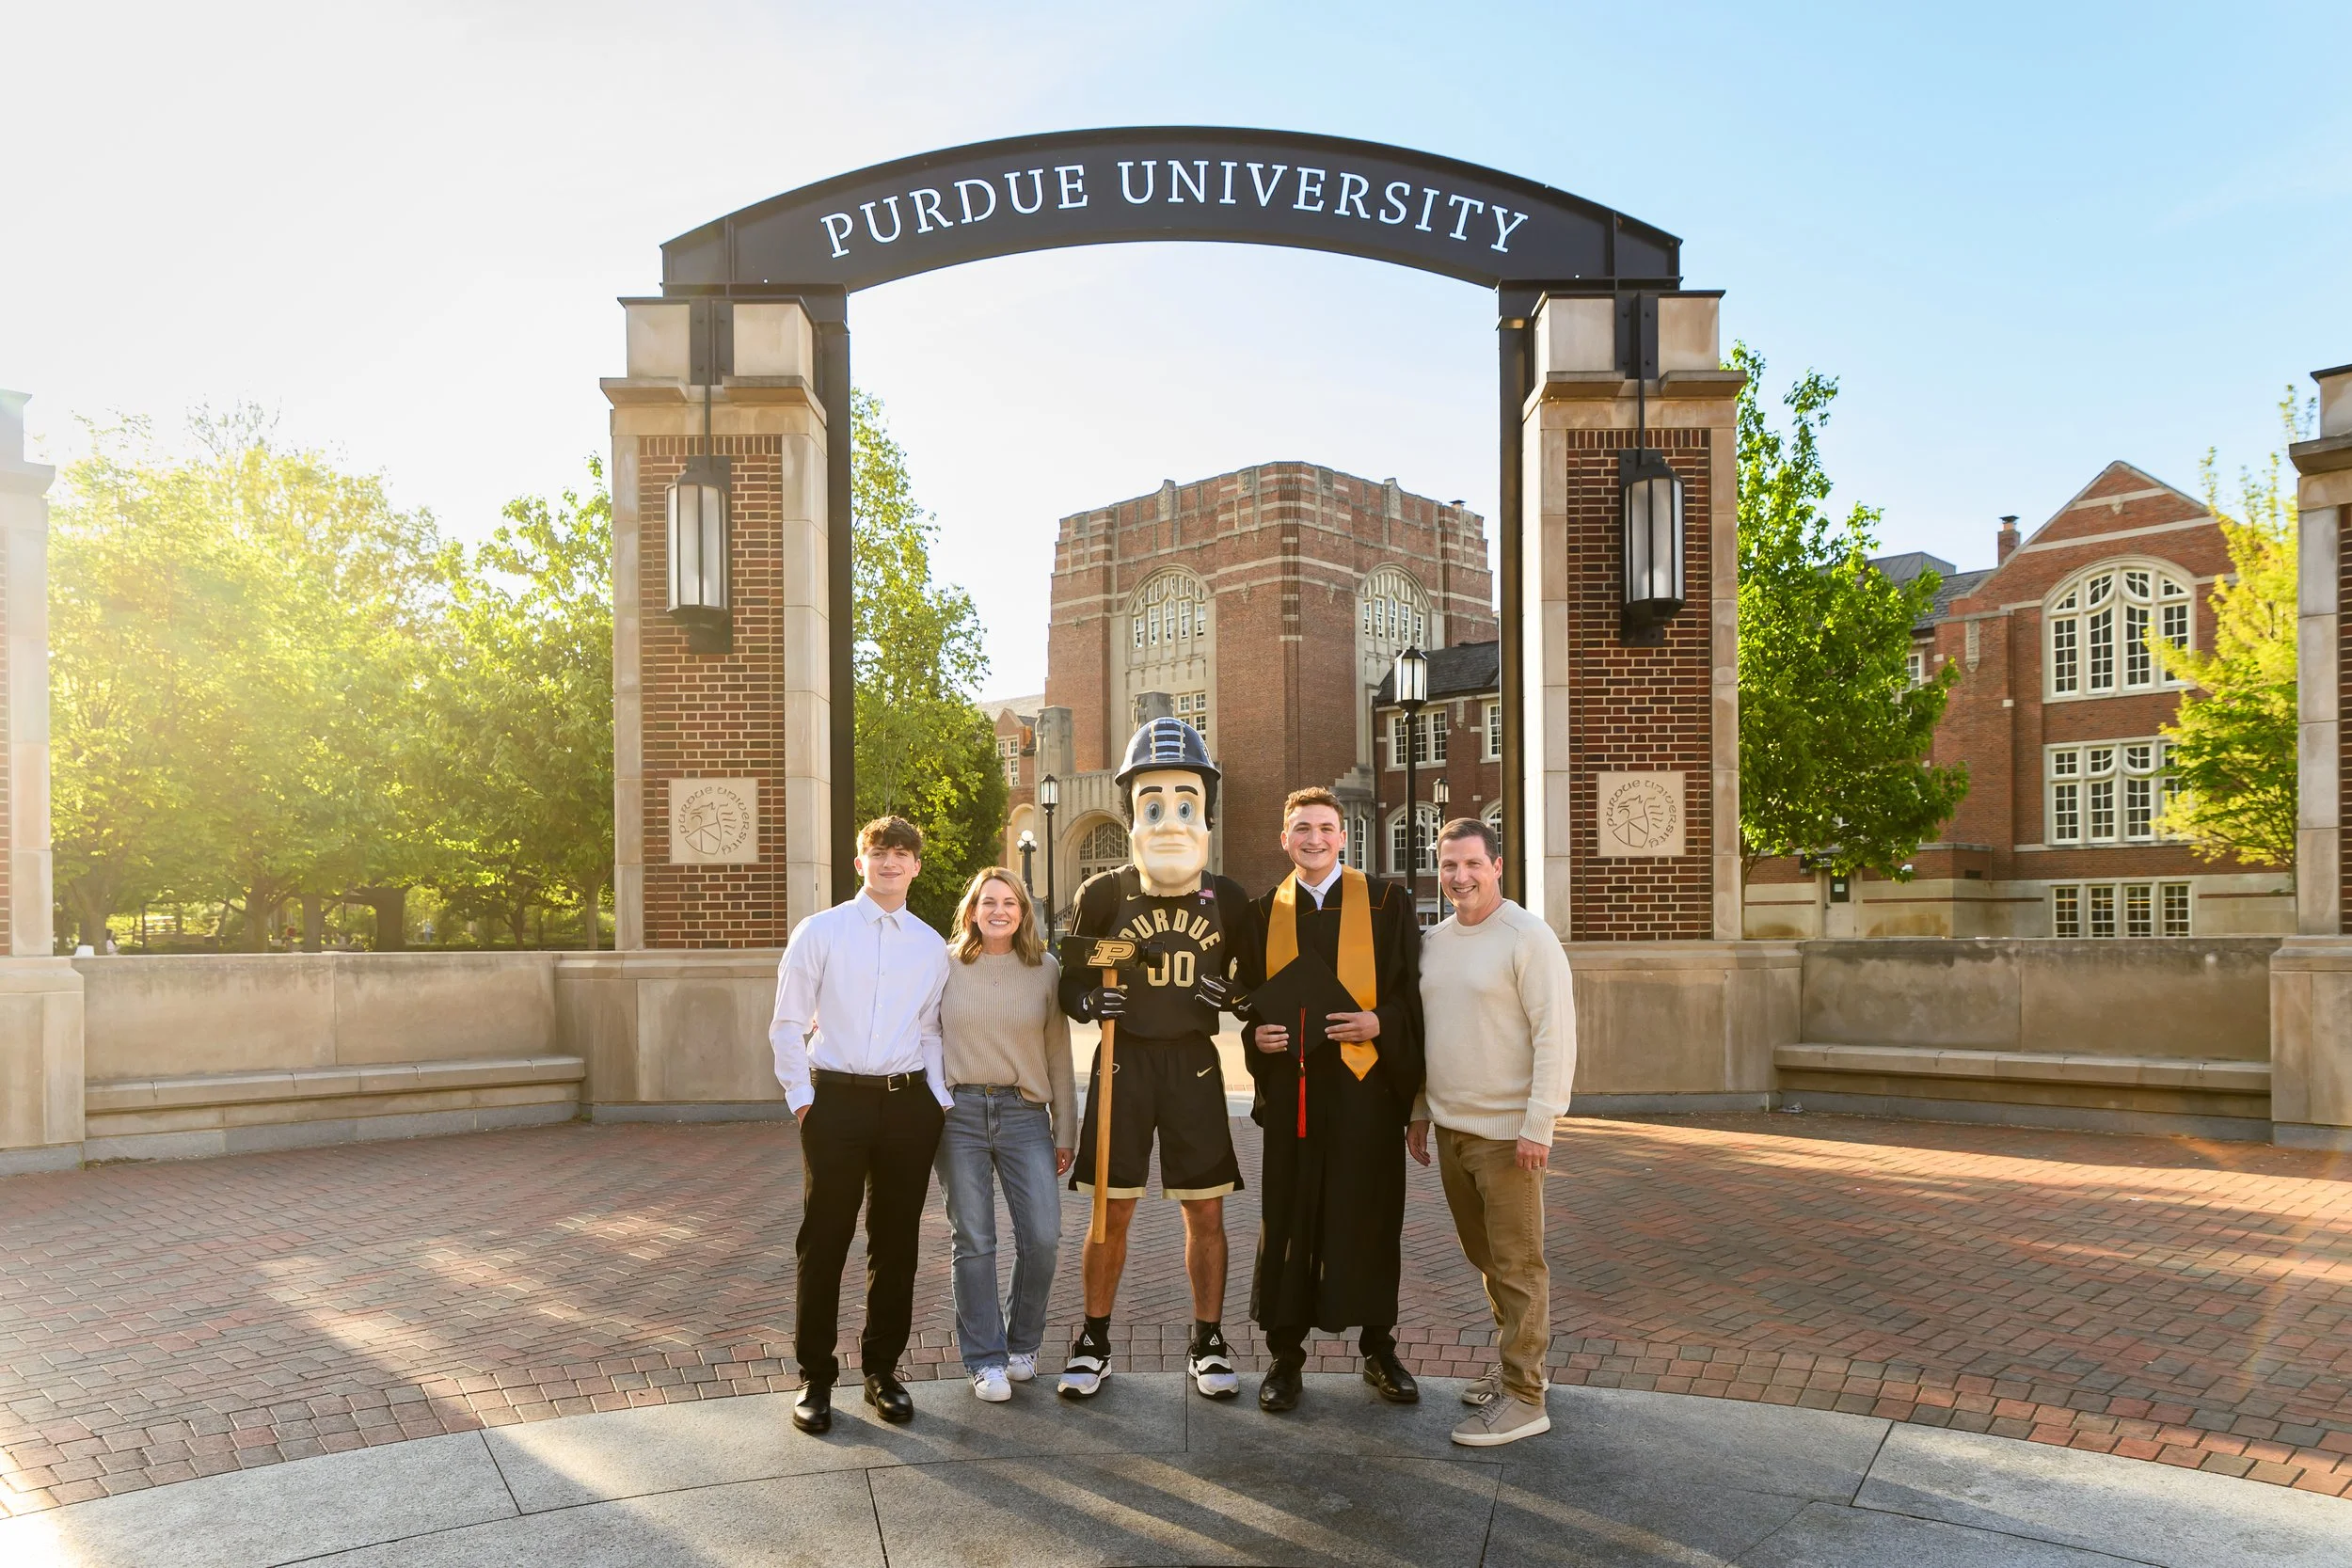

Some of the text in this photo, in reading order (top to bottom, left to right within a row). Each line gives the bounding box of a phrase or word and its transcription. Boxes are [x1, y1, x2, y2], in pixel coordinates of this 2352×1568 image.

[820, 159, 1529, 259] PURDUE UNIVERSITY
[1087, 940, 1136, 967] P
